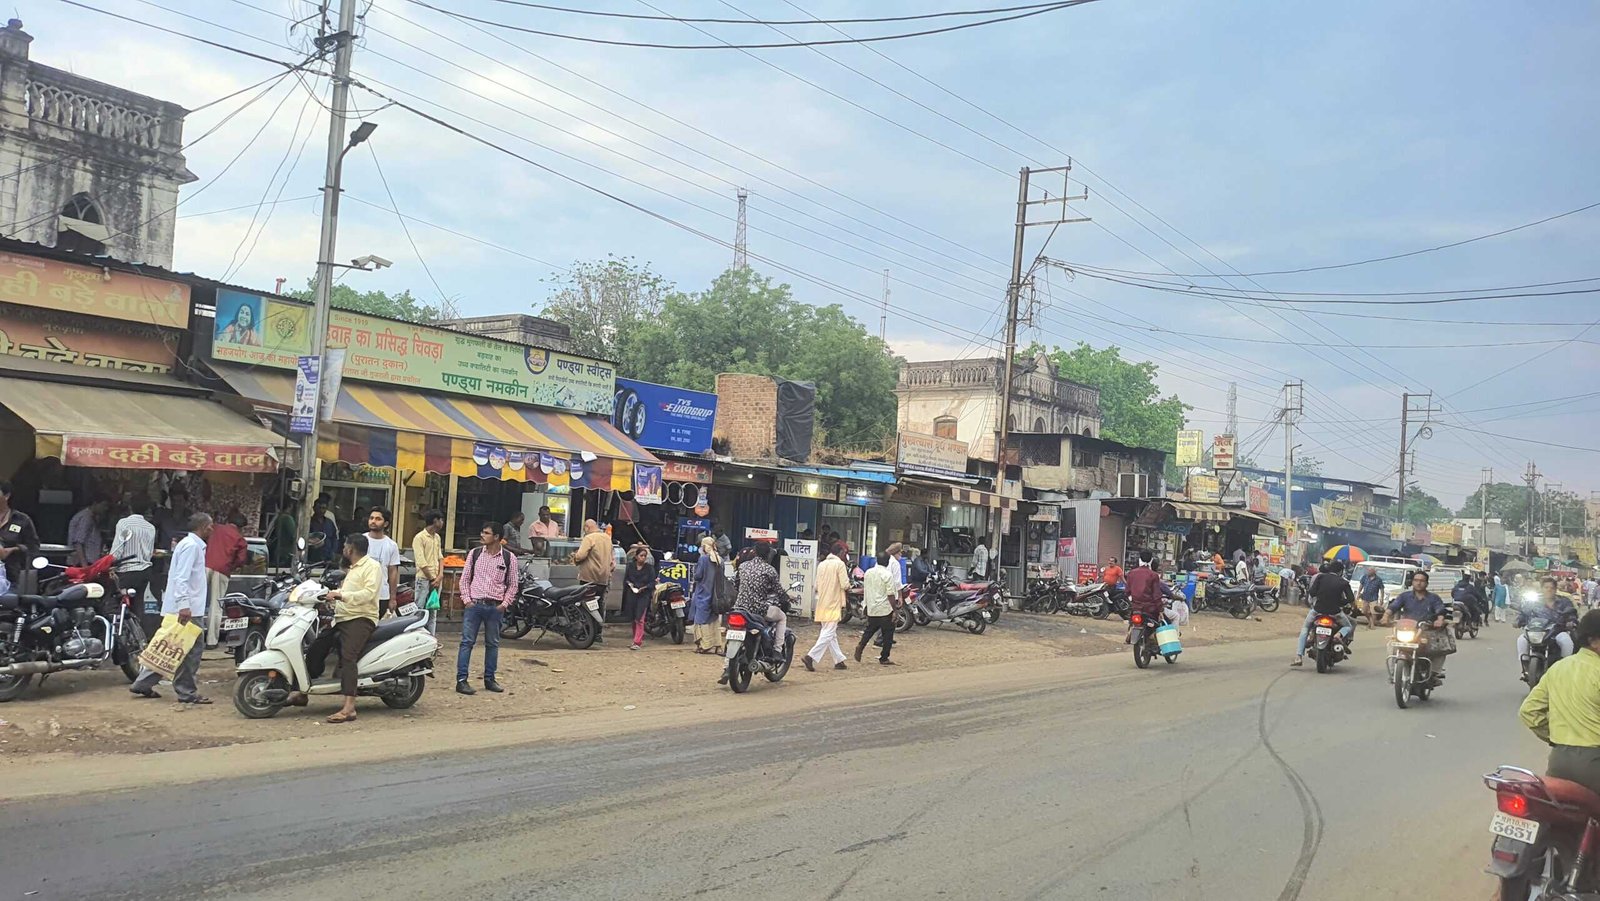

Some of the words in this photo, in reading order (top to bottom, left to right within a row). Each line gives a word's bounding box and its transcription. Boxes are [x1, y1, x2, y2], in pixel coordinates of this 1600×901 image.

[334, 313, 352, 323] Since
[356, 329, 372, 348] का
[375, 327, 409, 357] प्रसिद्ध
[412, 332, 444, 364] चिवड़ा
[217, 346, 247, 359] सहजयोग
[278, 353, 298, 366] महायो
[556, 358, 584, 376] पण्ड्या
[586, 361, 613, 381] स्वीट्स
[441, 372, 483, 393] पण्ड्या
[486, 378, 529, 398] नमकीन
[677, 398, 692, 406] TVS
[664, 403, 713, 418] EUROGRIP
[108, 443, 163, 463] दही
[168, 446, 208, 468] बड़े
[673, 462, 698, 474] टायर
[775, 476, 802, 494] पाटिल
[790, 540, 811, 555] पाटिल
[802, 560, 809, 570] घी
[789, 571, 805, 583] पनीर
[159, 660, 176, 671] ZONE
